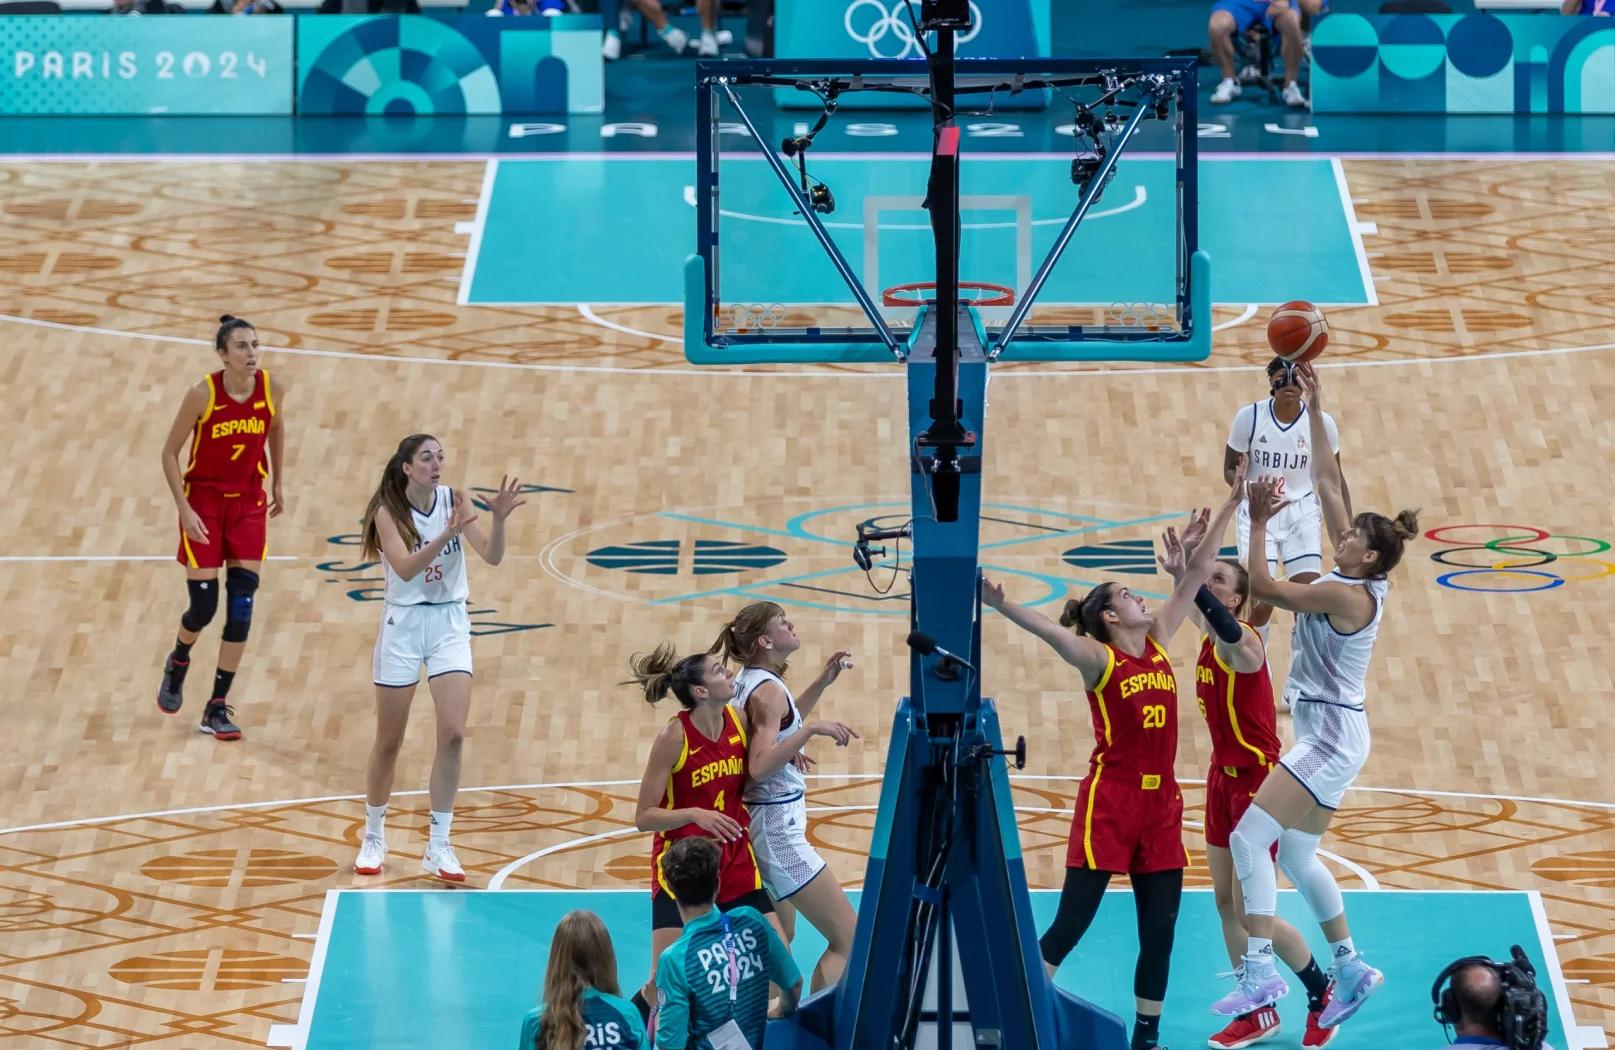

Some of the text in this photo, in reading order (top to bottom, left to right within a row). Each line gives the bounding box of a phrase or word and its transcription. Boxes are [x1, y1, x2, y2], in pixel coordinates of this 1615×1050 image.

[14, 50, 266, 79] PARIS 2024
[211, 416, 265, 439] ESPAÑA
[230, 444, 245, 461] 7
[424, 564, 443, 583] 25
[1119, 670, 1176, 699] ESPAÑA
[1142, 704, 1166, 729] 20
[691, 755, 744, 788] ESPAÑA
[713, 790, 725, 811] 4
